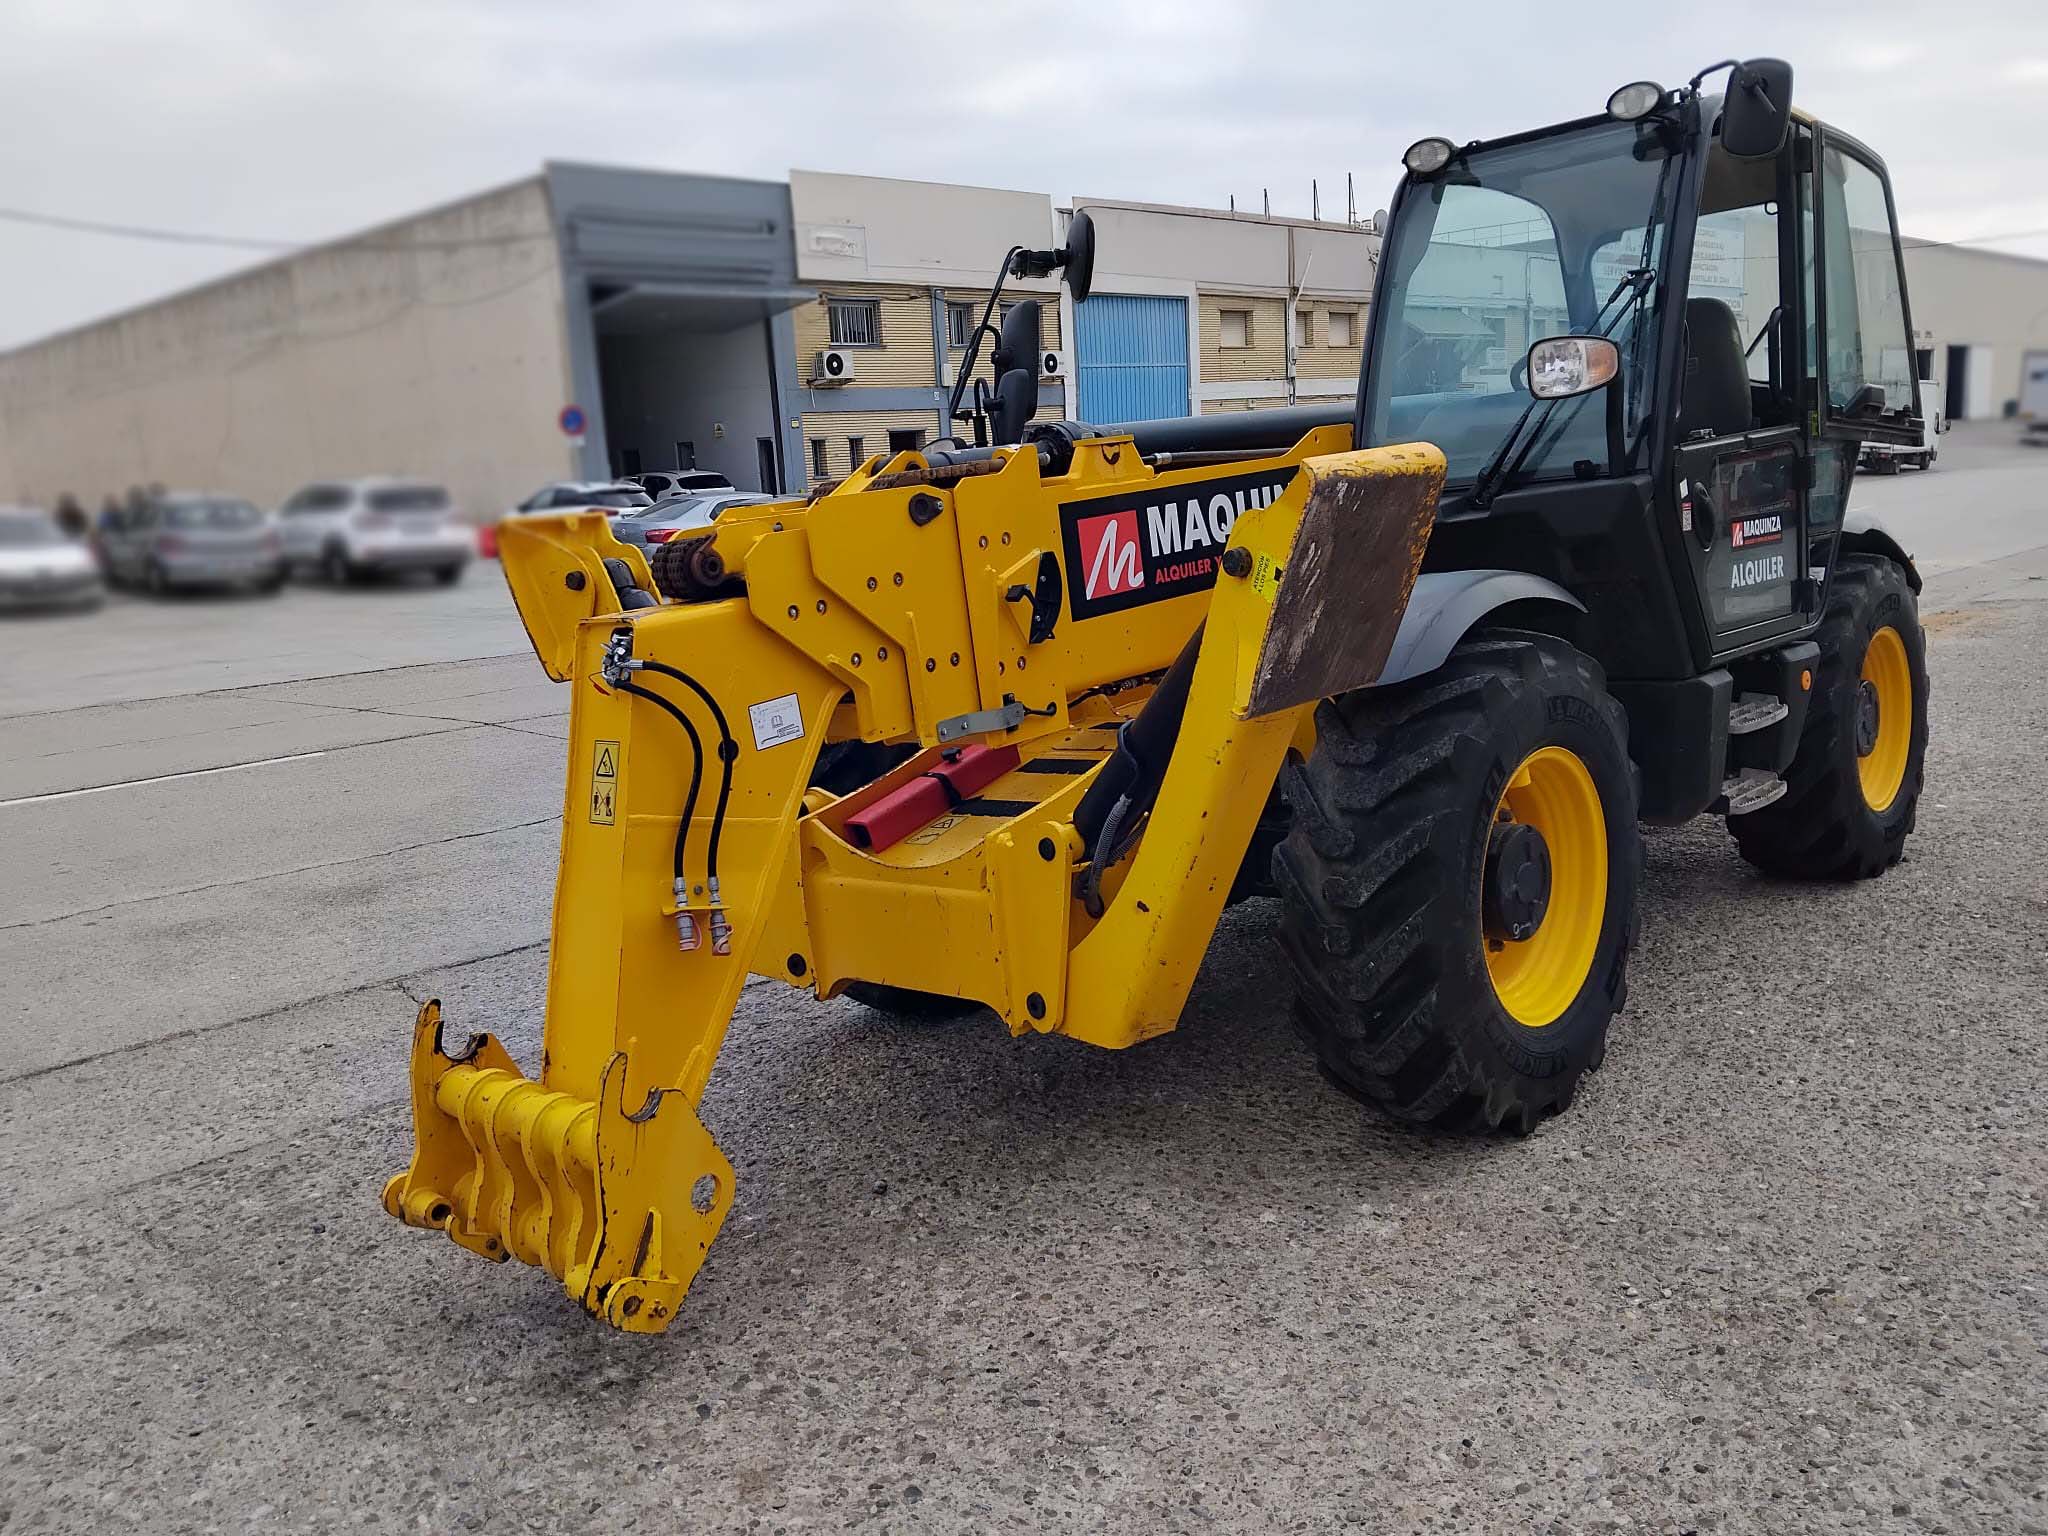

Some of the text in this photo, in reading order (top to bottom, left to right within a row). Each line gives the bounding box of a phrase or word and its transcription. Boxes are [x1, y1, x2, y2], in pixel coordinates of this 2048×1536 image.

[1146, 484, 1284, 557] MAQ
[1743, 516, 1781, 537] MAQUINZA
[1155, 558, 1212, 585] ALQUILER
[1731, 556, 1784, 588] ALQUILER
